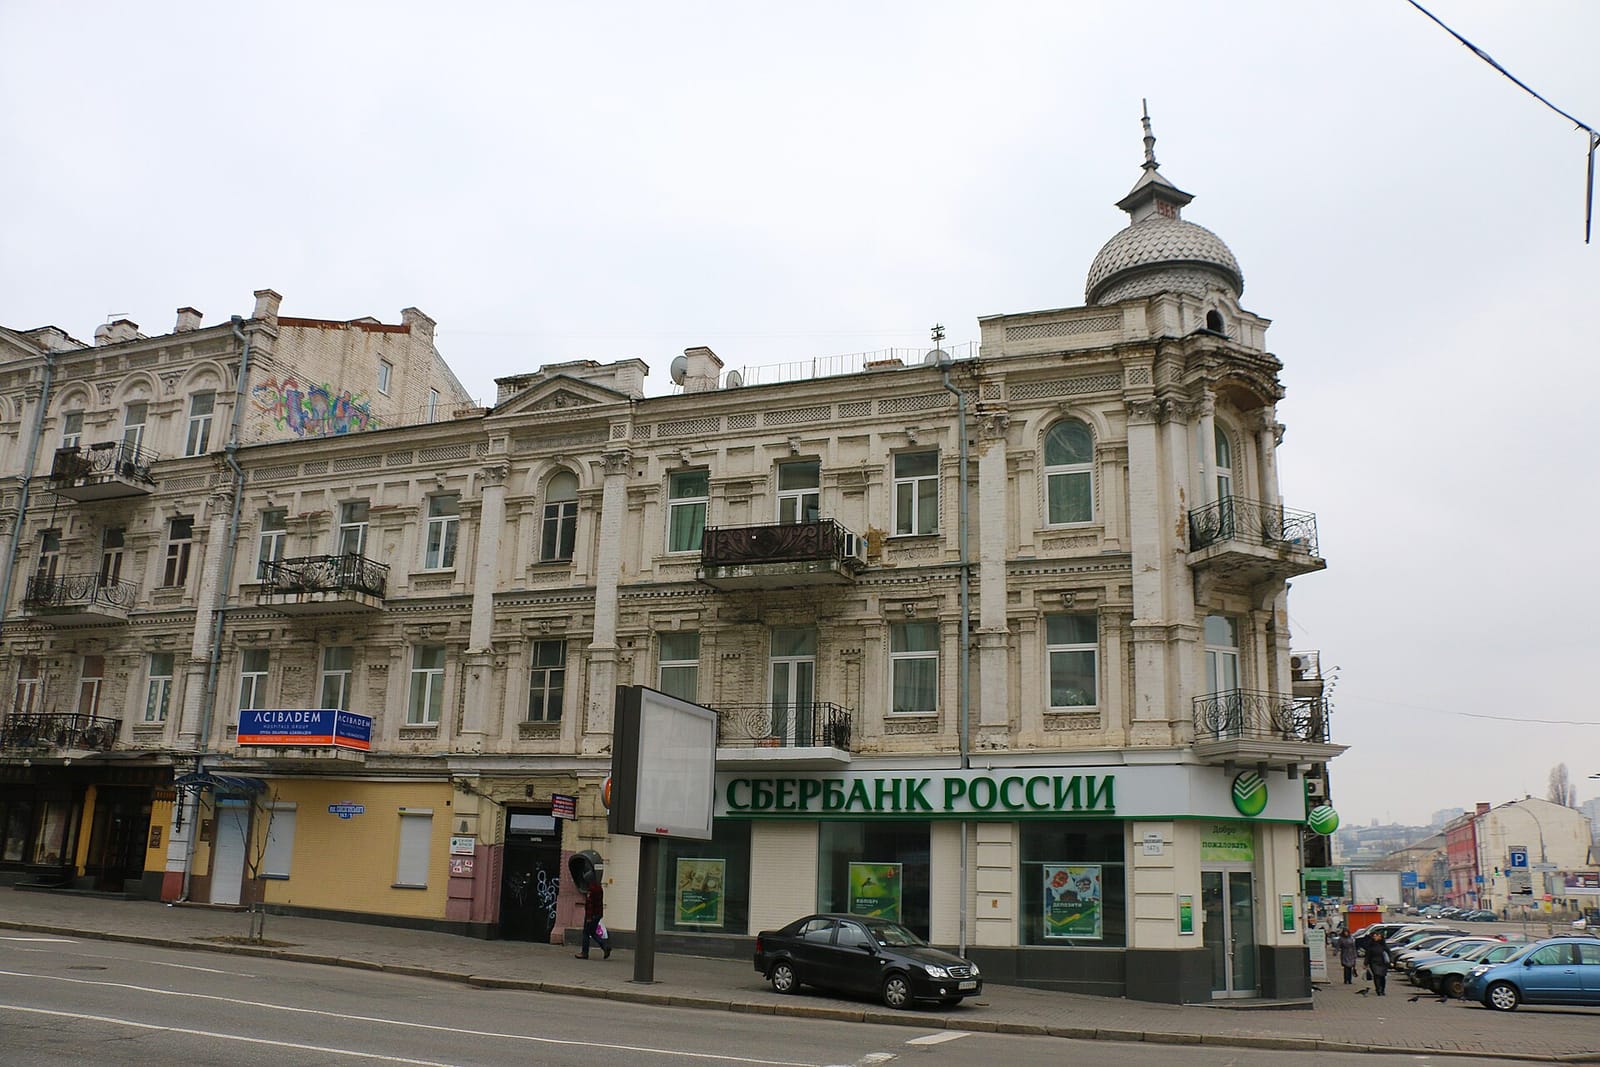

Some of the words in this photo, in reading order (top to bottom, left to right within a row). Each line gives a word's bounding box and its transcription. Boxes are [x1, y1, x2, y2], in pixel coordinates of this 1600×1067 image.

[254, 711, 321, 723] ACIBADEM
[338, 714, 371, 727] ACIBADEM
[726, 778, 934, 811] СБЕРБАНК
[943, 775, 1116, 810] РОССИИ
